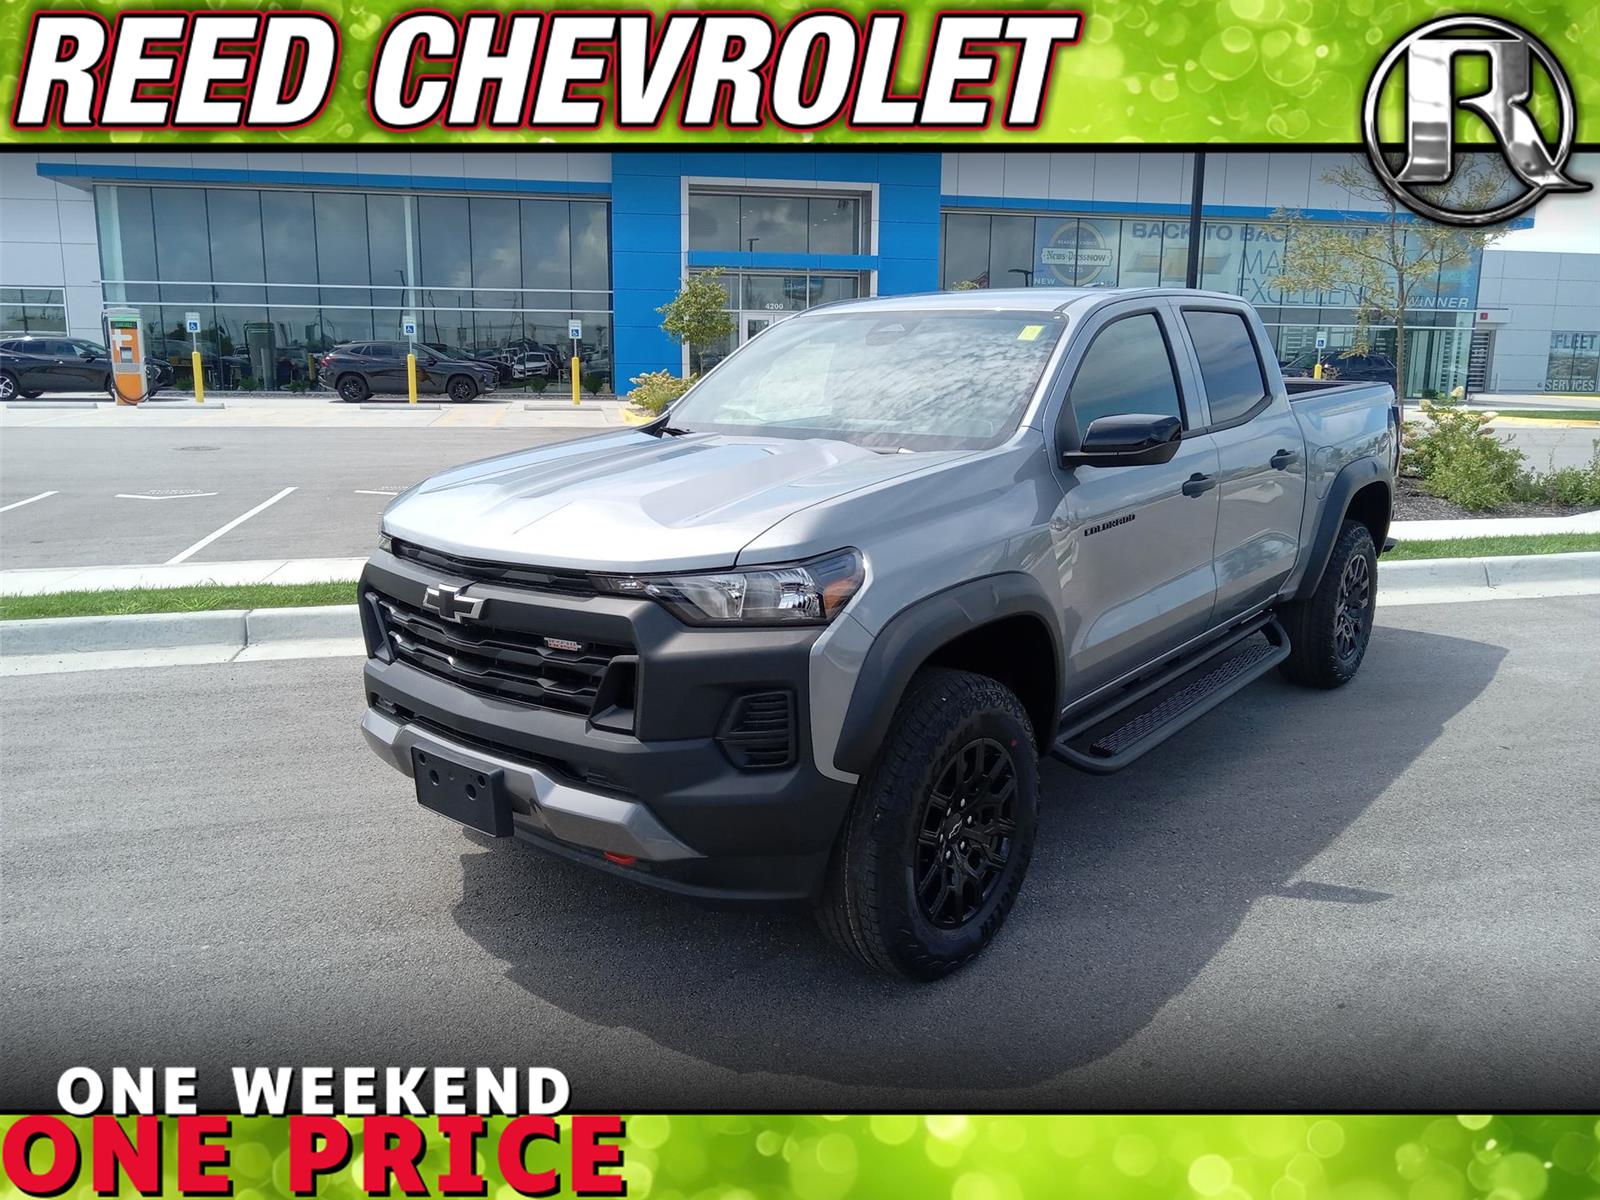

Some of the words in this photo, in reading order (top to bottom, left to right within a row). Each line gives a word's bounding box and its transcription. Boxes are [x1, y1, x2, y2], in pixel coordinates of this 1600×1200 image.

[1205, 225, 1233, 241] TO
[1033, 278, 1056, 286] NEW
[765, 302, 784, 310] 4200
[1405, 295, 1469, 308] WINNER
[1554, 333, 1597, 350] FLEET
[1545, 379, 1596, 392] SERVICES
